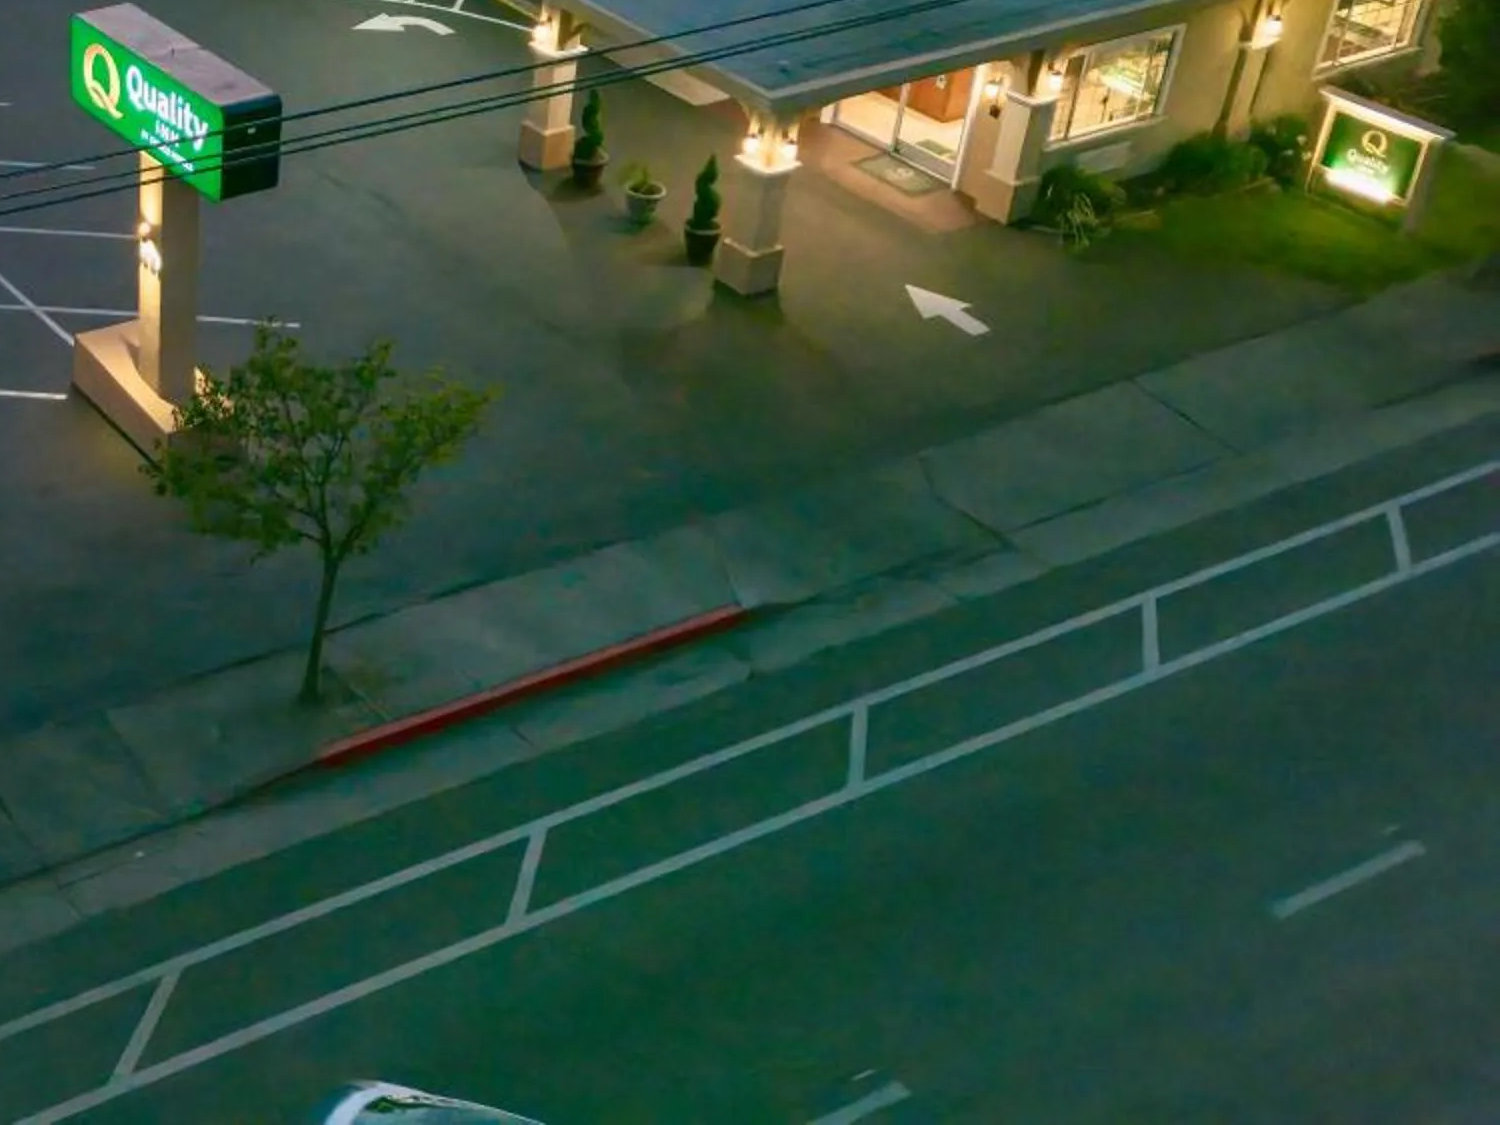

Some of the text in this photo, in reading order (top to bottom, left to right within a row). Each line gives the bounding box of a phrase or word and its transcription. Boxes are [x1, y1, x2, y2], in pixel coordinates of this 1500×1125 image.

[84, 43, 124, 119] Q
[126, 65, 208, 151] Quality
[1362, 130, 1387, 157] Q
